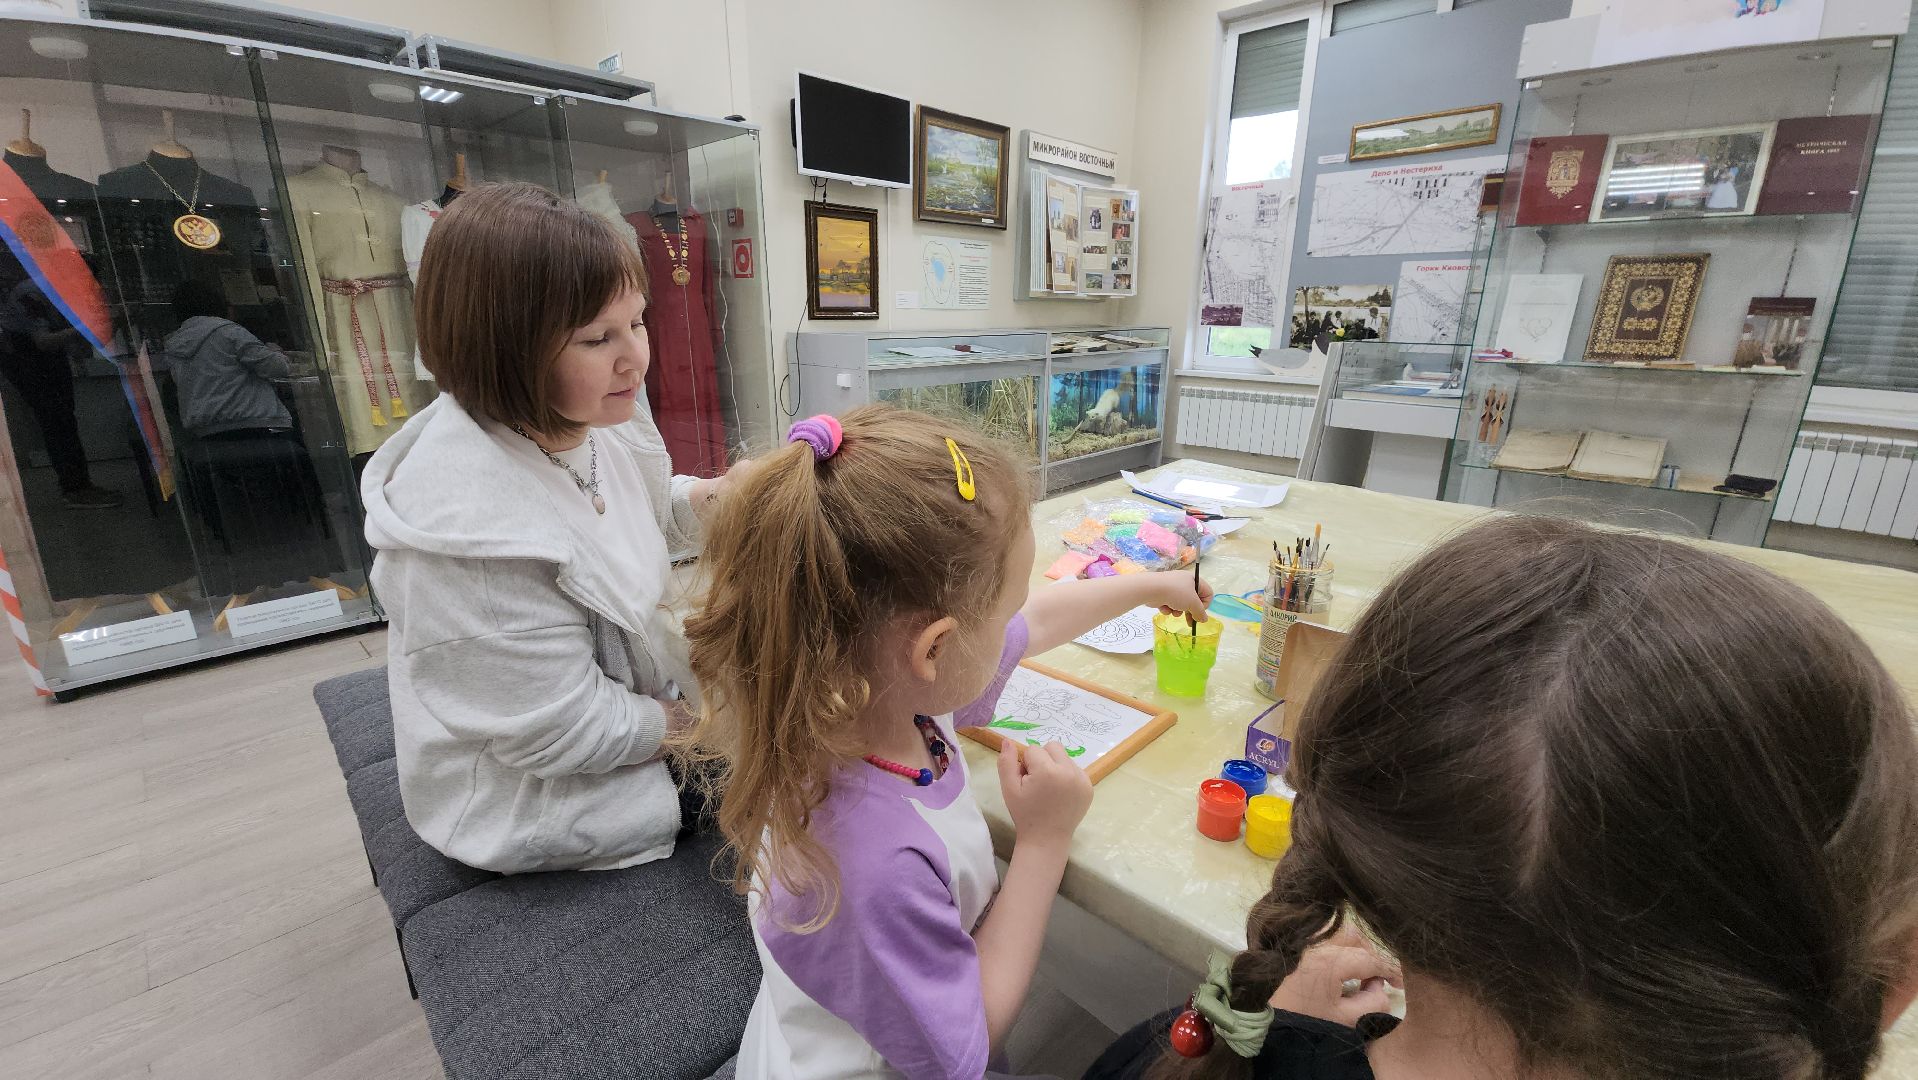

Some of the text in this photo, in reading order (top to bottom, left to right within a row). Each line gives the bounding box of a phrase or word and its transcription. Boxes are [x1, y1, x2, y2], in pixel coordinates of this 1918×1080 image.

[1032, 141, 1115, 170] МИКРОРАЙОН ВОСТОЧНЫЙ
[1371, 170, 1391, 178] Депо
[1400, 165, 1443, 175] Нестериха
[1248, 752, 1280, 769] ACRYL
